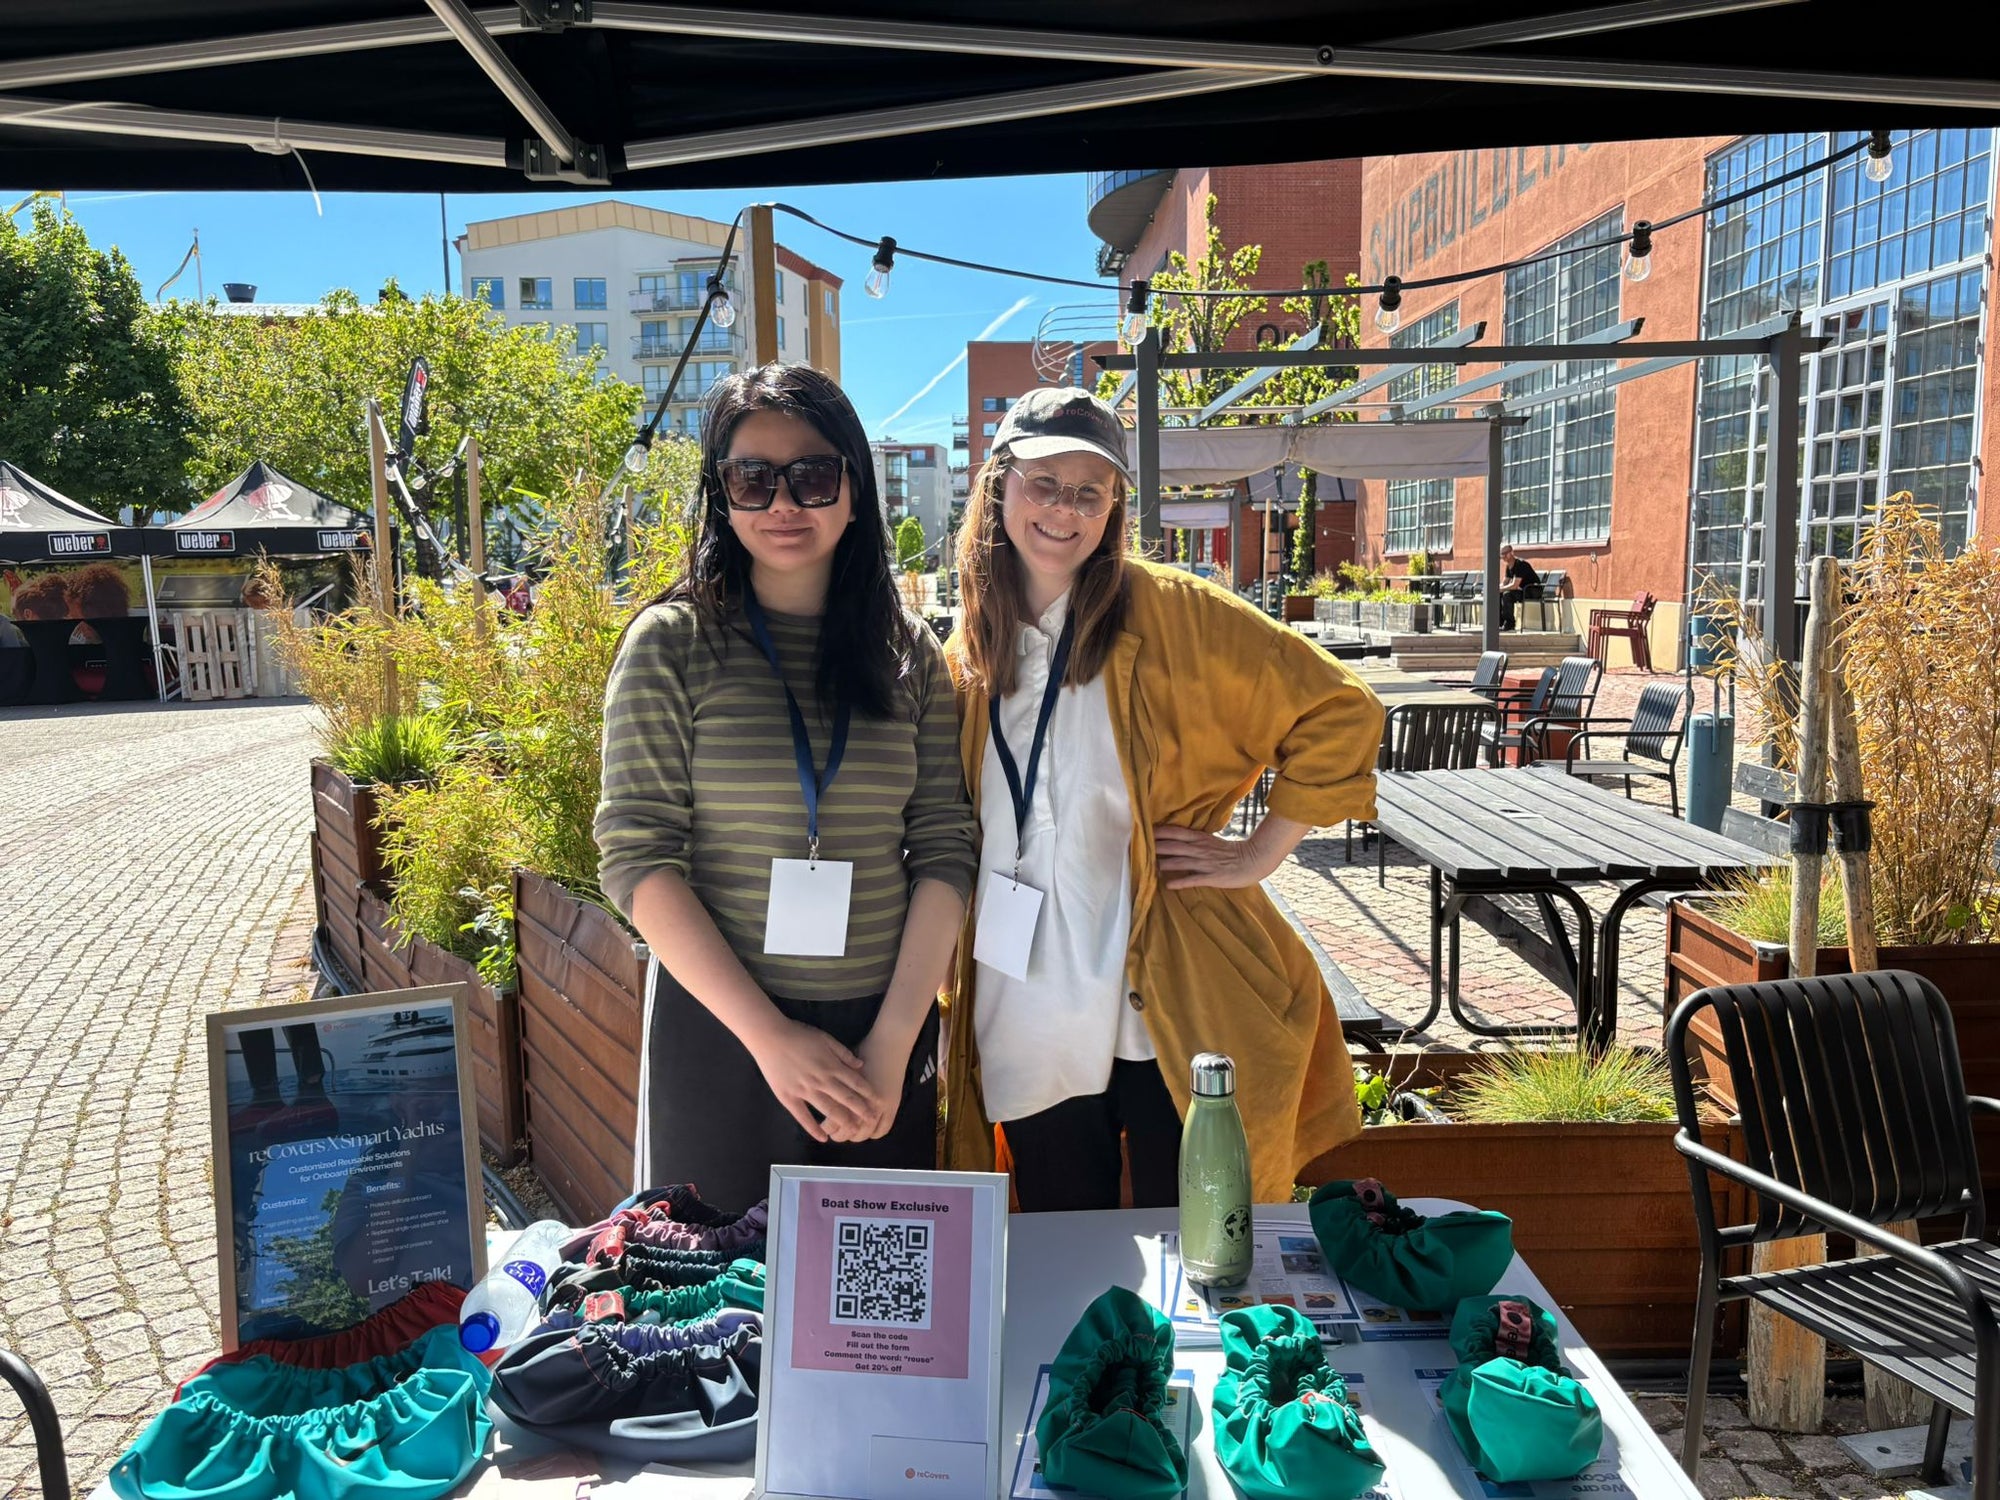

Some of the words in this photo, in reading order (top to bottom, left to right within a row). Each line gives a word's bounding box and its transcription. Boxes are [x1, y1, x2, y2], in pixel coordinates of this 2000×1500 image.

[1370, 144, 1591, 286] SHIPBUILD
[52, 534, 95, 552] weber
[180, 533, 220, 550] weber
[321, 533, 358, 548] weber
[248, 1139, 327, 1164] reCovers
[340, 1129, 391, 1149] Smart
[393, 1119, 446, 1142] Yachts
[288, 1161, 337, 1176] Customized
[337, 1155, 374, 1168] Reusable
[374, 1149, 411, 1162] Solutions
[299, 1174, 311, 1184] for
[312, 1168, 349, 1181] Onboard
[349, 1160, 404, 1176] Environments
[366, 1182, 402, 1194] Benefits:
[261, 1197, 309, 1211] Customize:
[821, 1198, 850, 1209] Boat
[853, 1199, 888, 1210] Show
[890, 1200, 950, 1213] Exclusive
[411, 1264, 452, 1282] Talk!
[851, 1330, 871, 1339] Scan
[873, 1332, 887, 1340] the
[888, 1333, 909, 1341] code
[860, 1342, 875, 1350] out
[876, 1342, 890, 1351] the
[891, 1343, 911, 1352] form
[824, 1350, 863, 1359] Comment
[864, 1352, 878, 1360] the
[880, 1353, 903, 1362] word:
[855, 1363, 870, 1371] Get
[871, 1363, 889, 1371] 20%
[890, 1364, 903, 1373] off
[1571, 1484, 1600, 1493] are
